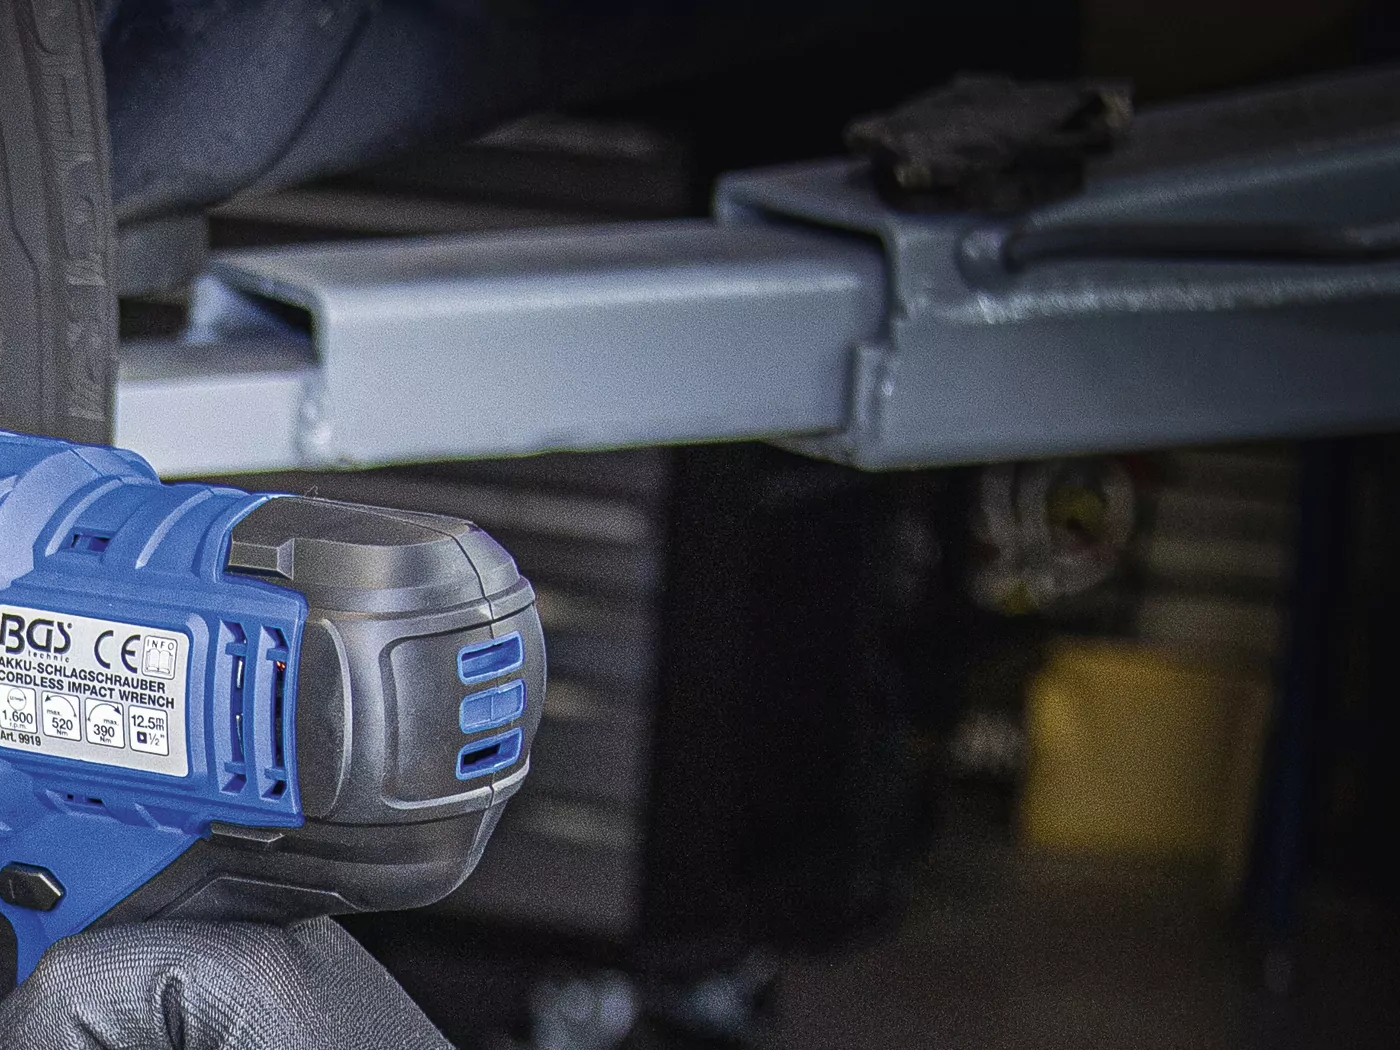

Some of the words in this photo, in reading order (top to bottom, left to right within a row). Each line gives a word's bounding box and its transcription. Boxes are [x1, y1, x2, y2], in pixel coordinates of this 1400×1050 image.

[146, 639, 175, 651] INFO
[27, 650, 70, 663] technic
[67, 681, 115, 700] IMPACT
[118, 688, 175, 709] WRENCH
[2, 709, 33, 724] 1.600
[46, 708, 62, 716] max.
[51, 717, 74, 731] 520
[103, 718, 119, 726] max.
[56, 728, 69, 737] Nm
[93, 724, 115, 738] 390
[0, 730, 17, 743] Art.
[18, 733, 42, 747] 9919
[99, 735, 112, 744] Nm
